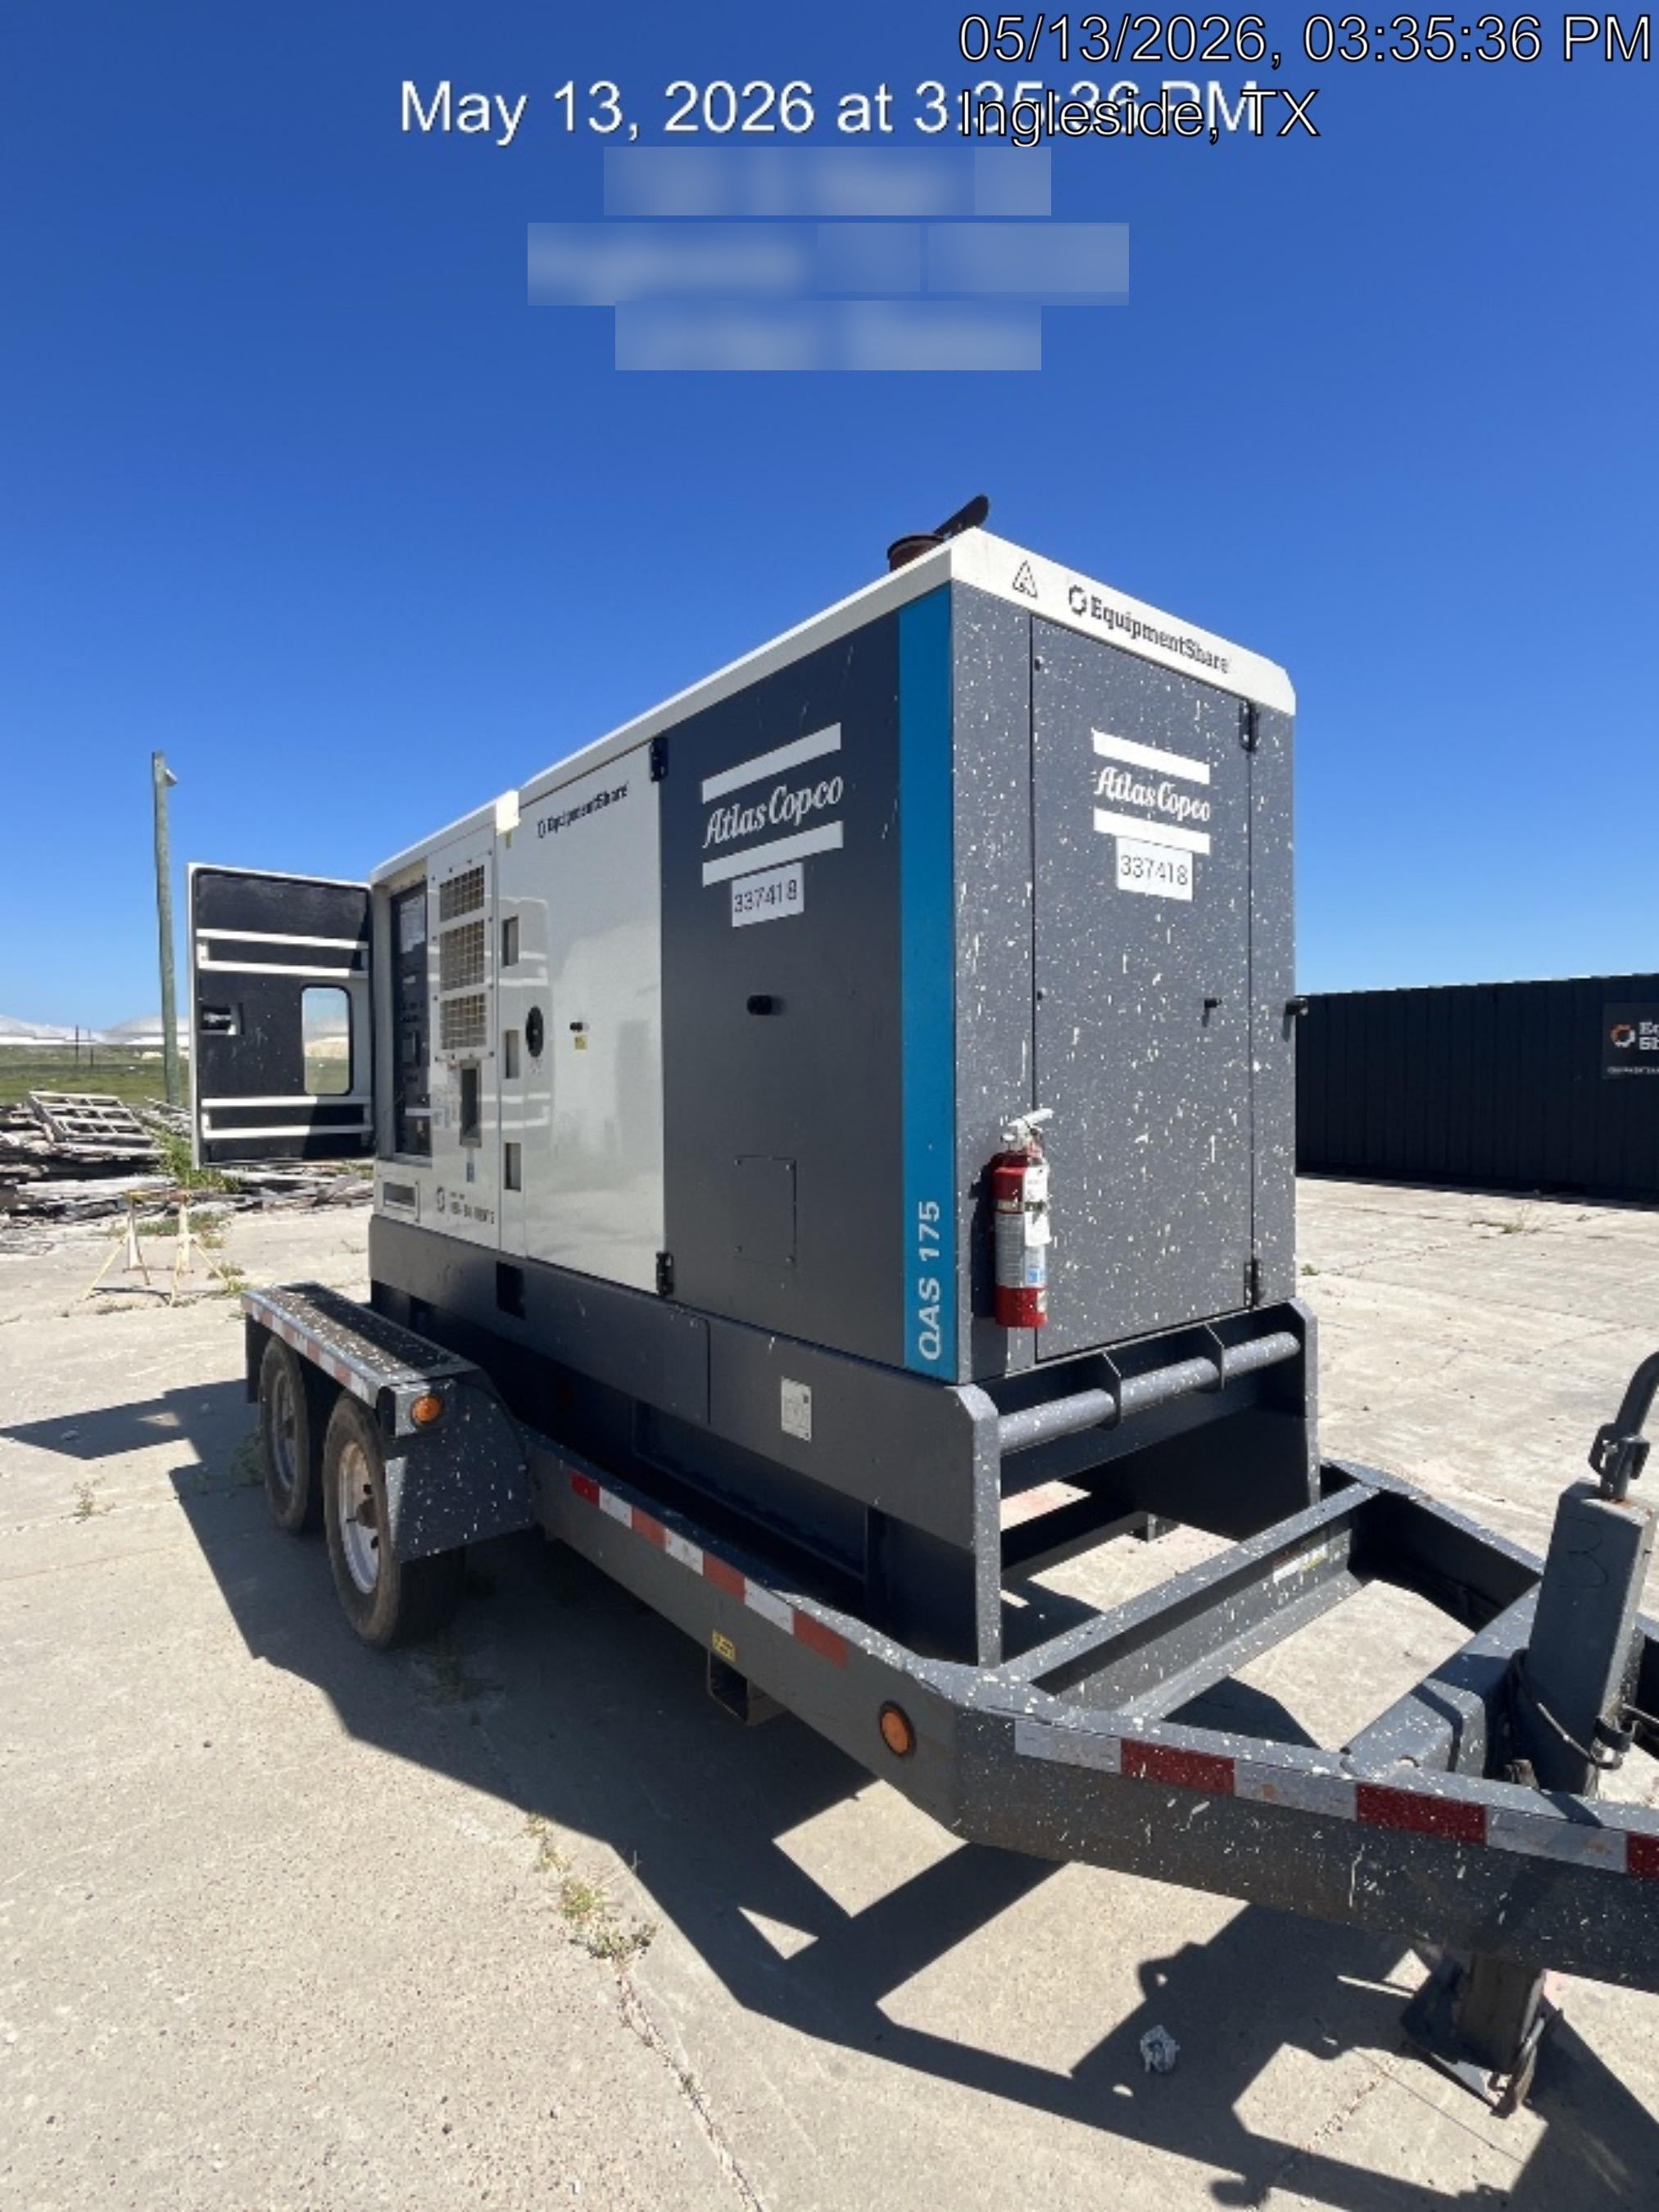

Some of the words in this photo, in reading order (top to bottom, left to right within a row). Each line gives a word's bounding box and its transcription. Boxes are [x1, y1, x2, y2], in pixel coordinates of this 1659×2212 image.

[1090, 593, 1230, 674] EquipmentShare
[734, 879, 798, 913] 337418
[1120, 854, 1189, 886] 337418
[918, 1201, 941, 1262] 175
[918, 1276, 941, 1361] QAS
